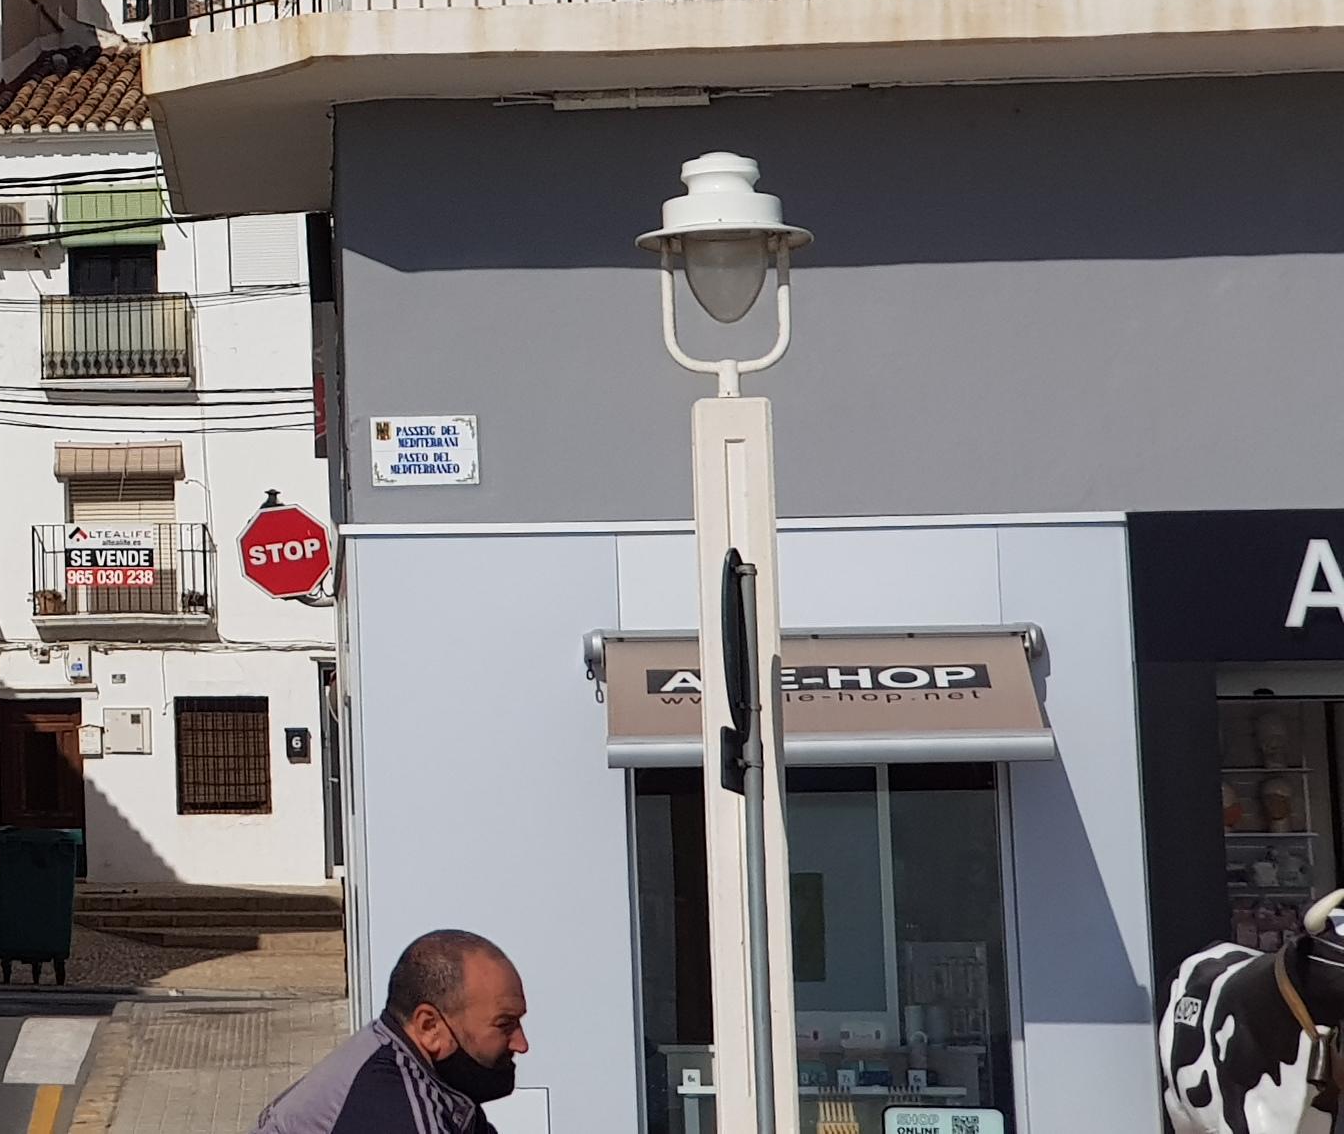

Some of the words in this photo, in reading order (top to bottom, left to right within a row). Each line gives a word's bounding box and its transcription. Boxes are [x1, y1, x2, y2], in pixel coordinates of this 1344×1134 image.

[396, 426, 436, 436] PASSEIG
[441, 425, 460, 436] DEL
[398, 452, 428, 462] PASEO
[434, 452, 452, 462] DEL
[70, 550, 91, 566] SE
[95, 550, 149, 566] VENDE
[249, 538, 321, 566] STOP
[67, 570, 93, 584] 965
[97, 570, 123, 584] 030
[127, 570, 153, 584] 238
[292, 736, 302, 748] 6
[896, 1114, 939, 1125] SHOP
